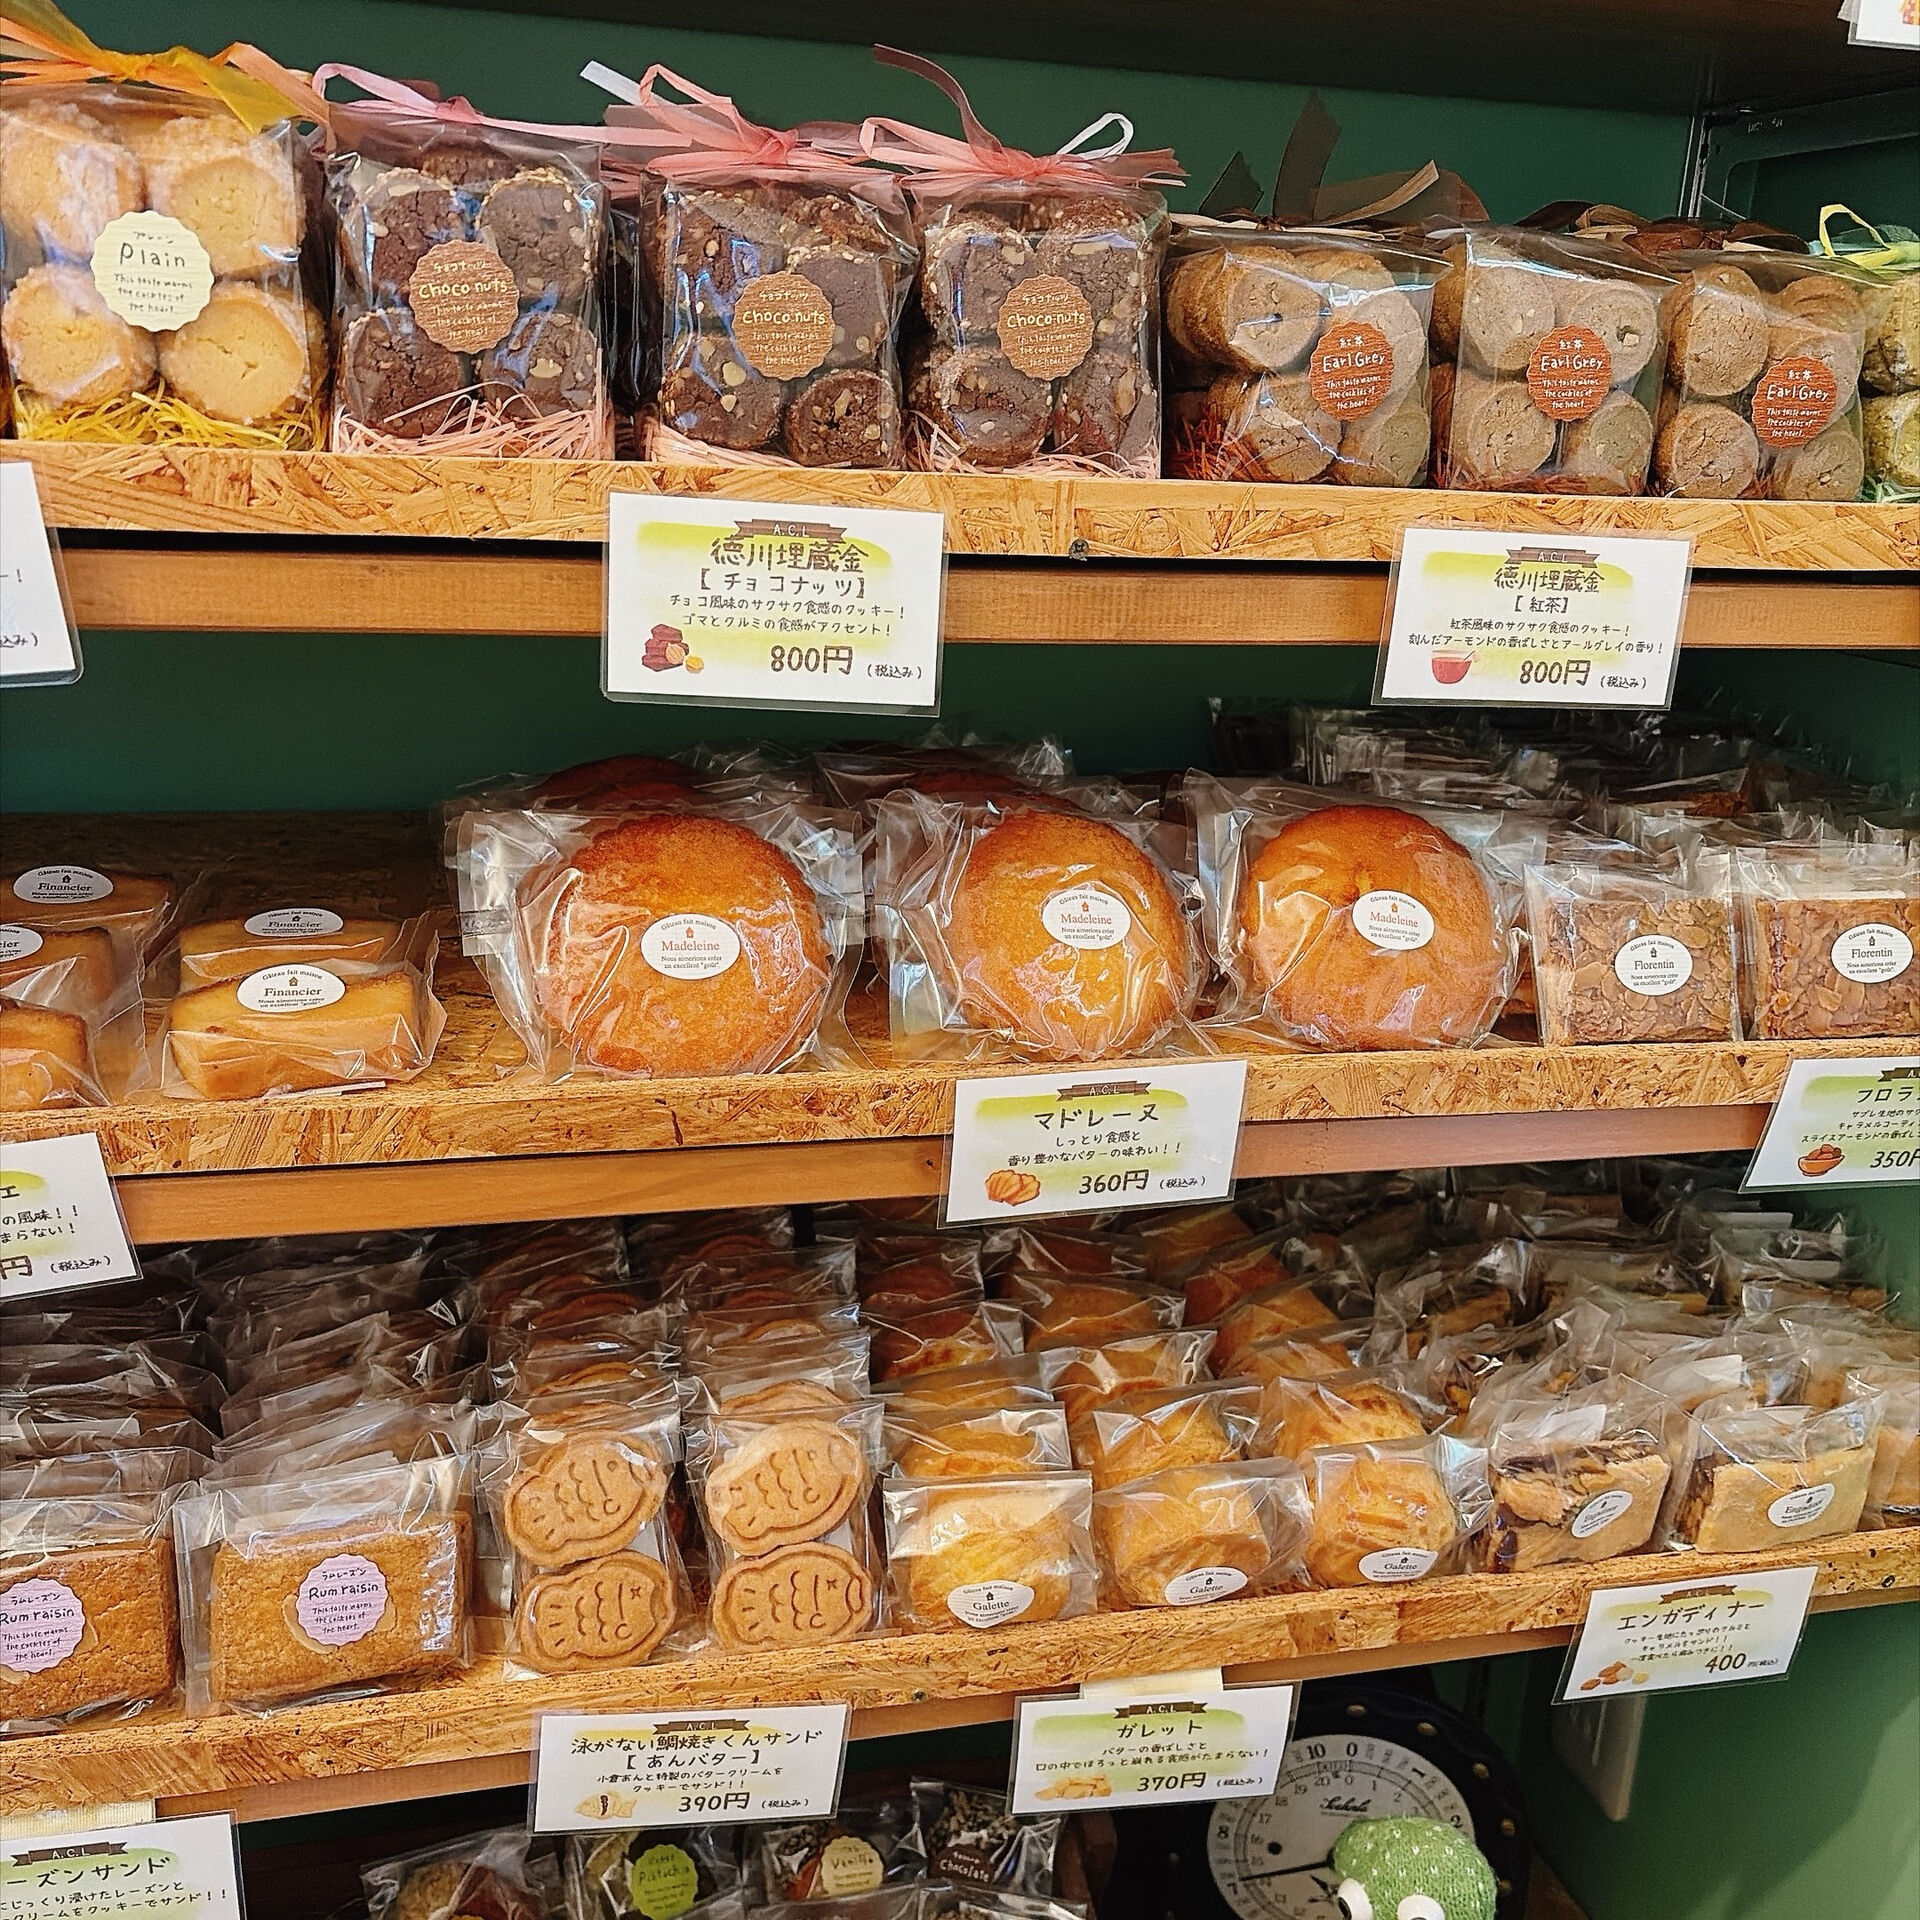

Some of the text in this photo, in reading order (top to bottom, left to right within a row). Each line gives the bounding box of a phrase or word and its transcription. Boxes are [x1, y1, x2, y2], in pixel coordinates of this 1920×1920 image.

[119, 242, 185, 268] Plain
[474, 279, 508, 293] nuts
[794, 310, 826, 325] nuts
[1055, 310, 1085, 325] nuts
[1559, 339, 1584, 350] 紅茶
[1322, 351, 1386, 373] Earl Grey
[1540, 354, 1603, 371] Earl Grey
[1788, 369, 1812, 380] 紅茶
[1767, 384, 1829, 401] Earl Grey
[710, 536, 869, 574] 徳川埋蔵金
[1494, 566, 1605, 594] 徳川埋蔵金
[770, 645, 853, 675] 800円
[1519, 659, 1591, 687] 800円
[38, 882, 92, 892] Financier
[1060, 914, 1112, 925] Madeleine
[1369, 911, 1419, 928] Madeleine
[661, 940, 720, 951] Madeleine
[1851, 948, 1893, 958] Florentin
[1634, 959, 1675, 970] Florentin
[264, 987, 322, 997] Financier
[1858, 1087, 1920, 1103] フロラ
[1033, 1103, 1160, 1131] マドレーヌ
[1839, 1119, 1920, 1130] キャラメルコーティ
[1055, 1131, 1142, 1148] しっとり食感と
[1079, 1169, 1150, 1195] 360円
[322, 1567, 367, 1581] ラムレーズン
[11, 1592, 61, 1606] ラムレーズン
[309, 1583, 379, 1600] Rum raisin
[973, 1601, 1010, 1611] Galette
[0, 1608, 75, 1626] Rum raisin
[1617, 1600, 1765, 1631] エンガディナー
[1117, 1720, 1203, 1738] ガレット
[571, 1729, 823, 1755] 泳がない鯛焼きくんサンド
[1346, 1742, 1358, 1757] 0
[1306, 1742, 1326, 1760] 10
[1137, 1772, 1207, 1792] 370円
[678, 1792, 750, 1813] 390円
